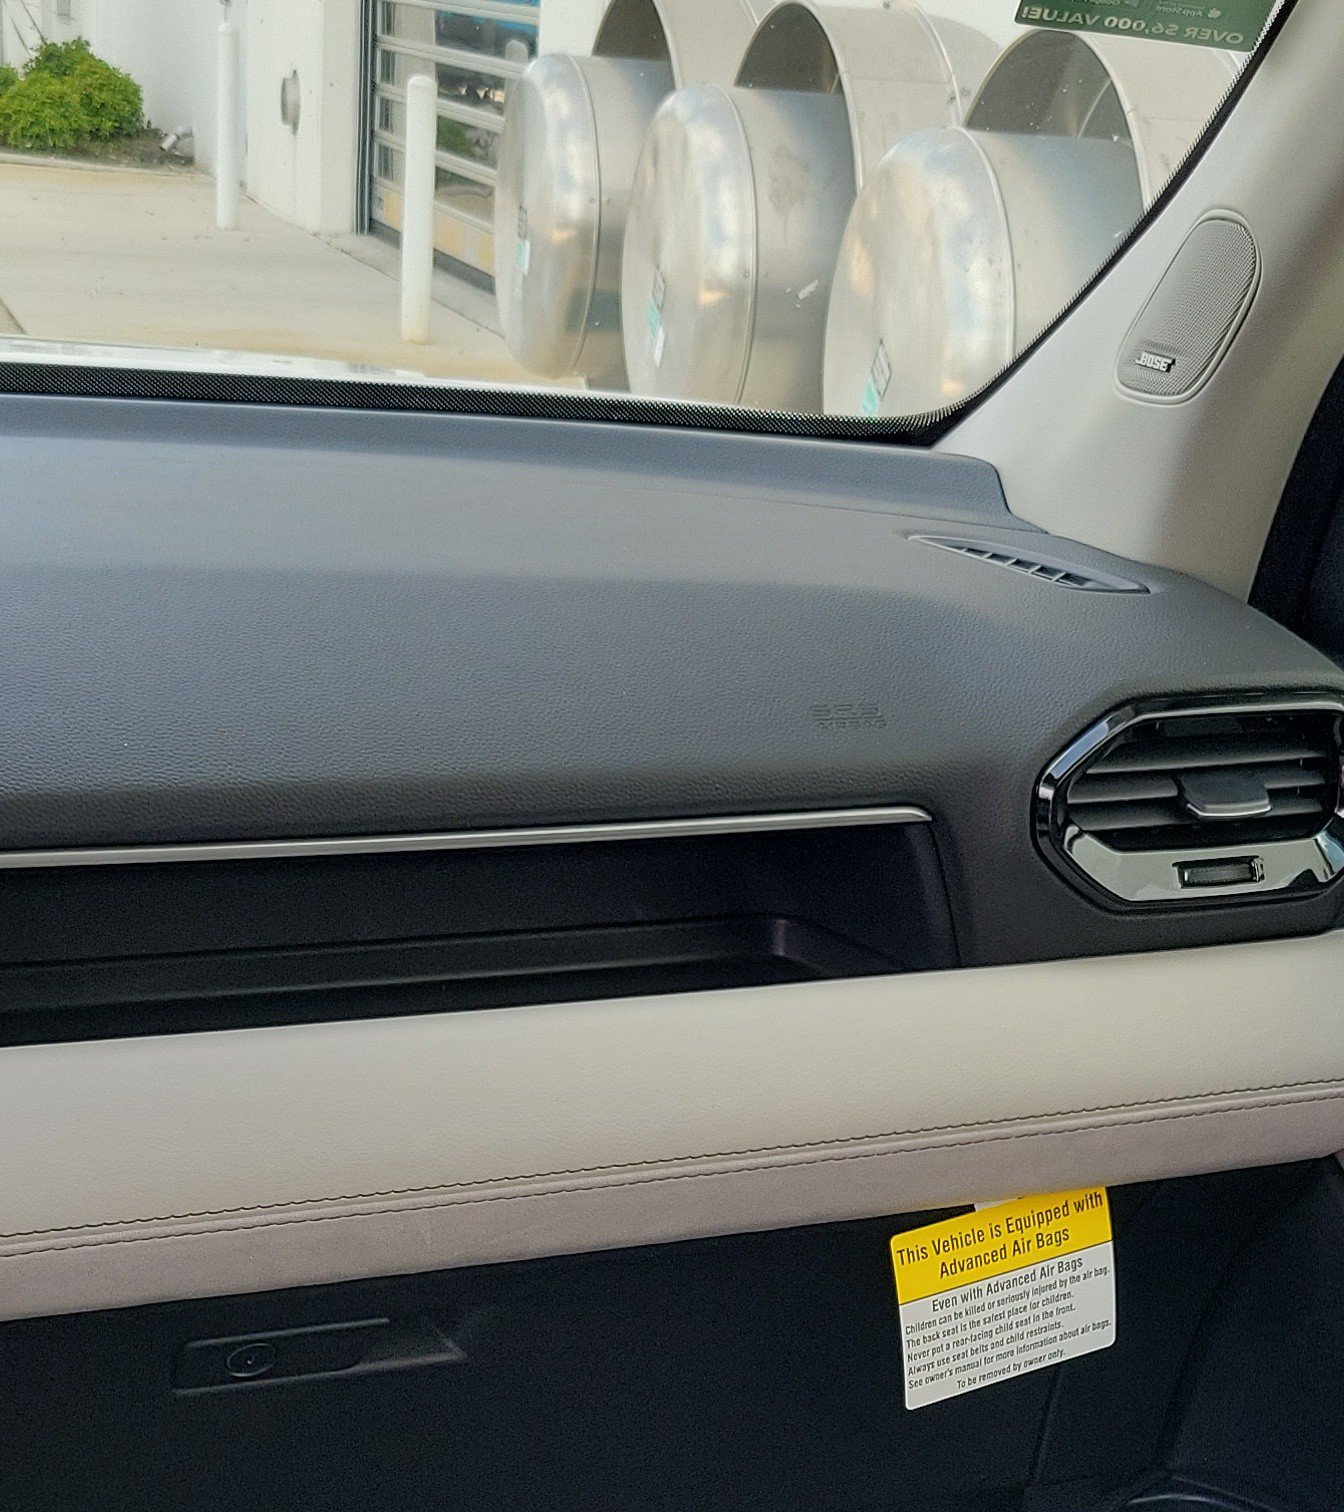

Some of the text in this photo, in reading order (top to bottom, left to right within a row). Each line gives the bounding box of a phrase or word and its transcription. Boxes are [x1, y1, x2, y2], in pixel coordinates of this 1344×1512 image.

[1135, 351, 1173, 371] BOSE
[897, 1191, 1103, 1266] This Vehicle is Equipped with
[939, 1228, 1070, 1279] Advanced Air Bags
[905, 1319, 937, 1335] Children
[938, 1315, 952, 1325] can
[954, 1311, 963, 1320] be
[965, 1303, 986, 1317] killed
[987, 1301, 995, 1310] or
[997, 1290, 1030, 1307] seriously
[1032, 1281, 1057, 1296] injured
[1059, 1279, 1068, 1289] by
[1069, 1275, 1081, 1285] the
[1083, 1271, 1093, 1280] air
[932, 1258, 1083, 1312] Even with Advanced Air Bags
[907, 1338, 921, 1349] The
[923, 1331, 940, 1344] back
[942, 1325, 958, 1338] seat
[960, 1323, 967, 1332] is
[969, 1317, 981, 1328] the
[983, 1311, 1005, 1325] safest
[1007, 1305, 1027, 1319] place
[1029, 1301, 1040, 1310] for
[907, 1350, 930, 1363] Never
[932, 1344, 944, 1357] put
[952, 1328, 993, 1349] rear-facing
[995, 1321, 1013, 1335] child
[1015, 1316, 1031, 1328] seat
[1033, 1313, 1040, 1322] in
[1042, 1310, 1054, 1320] the
[908, 1361, 935, 1376] Always
[937, 1356, 950, 1367] use
[952, 1351, 968, 1362] seat
[970, 1344, 988, 1357] belts
[990, 1338, 1004, 1349] and
[1006, 1332, 1024, 1345] child
[908, 1378, 923, 1389] See
[925, 1369, 953, 1384] owner's
[954, 1359, 982, 1375] manual
[983, 1355, 995, 1366] for
[996, 1348, 1014, 1360] more
[1016, 1335, 1057, 1354] information
[1059, 1328, 1080, 1342] about
[1080, 1324, 1091, 1335] air
[957, 1380, 966, 1389] To
[967, 1376, 977, 1387] be
[979, 1365, 1011, 1382] removed
[1012, 1361, 1021, 1372] by
[1023, 1354, 1047, 1368] owner
